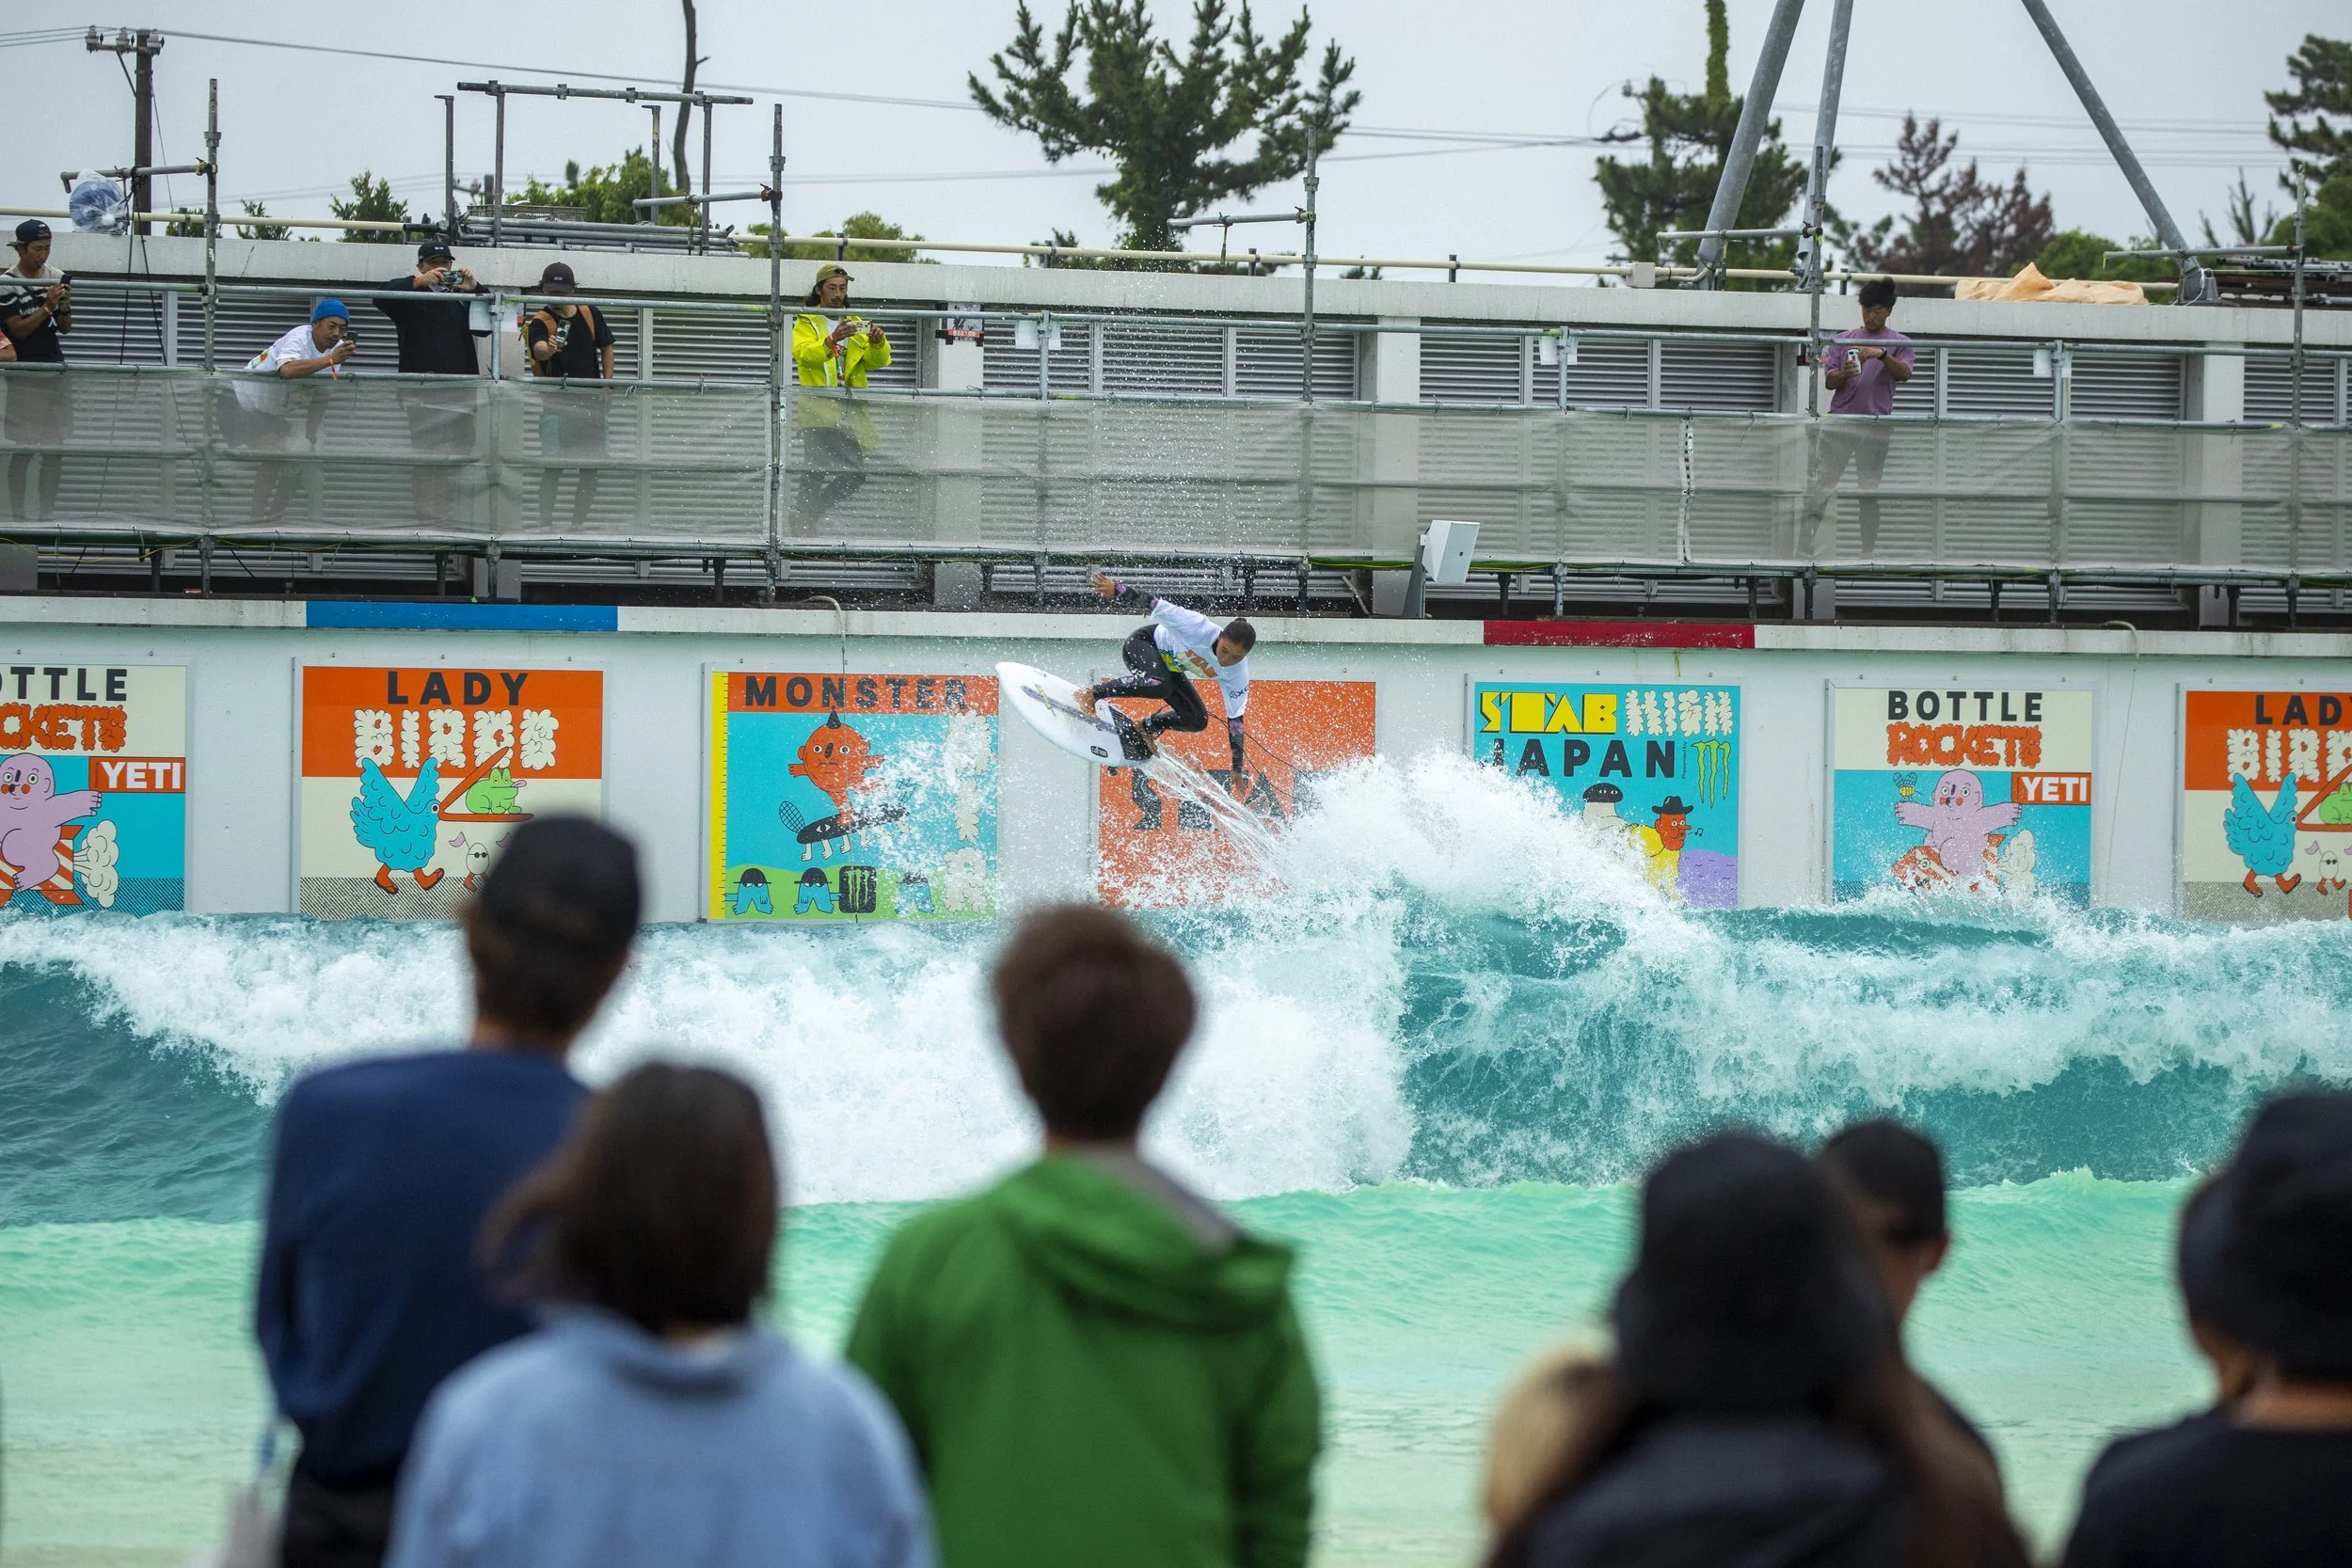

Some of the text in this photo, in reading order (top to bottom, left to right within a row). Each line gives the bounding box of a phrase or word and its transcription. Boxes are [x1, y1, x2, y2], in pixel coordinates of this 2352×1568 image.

[0, 666, 128, 702] TTLE
[387, 671, 529, 706] LADY
[745, 675, 968, 710] MONSTER
[1480, 689, 1733, 737] STAB HIGH
[1887, 689, 2042, 722] BOTTLE
[2255, 694, 2352, 726] LAD
[353, 708, 560, 770] BIRDS
[1886, 721, 2042, 768] ROCKETS
[101, 761, 182, 789] YETI
[2021, 776, 2088, 801] YETI
